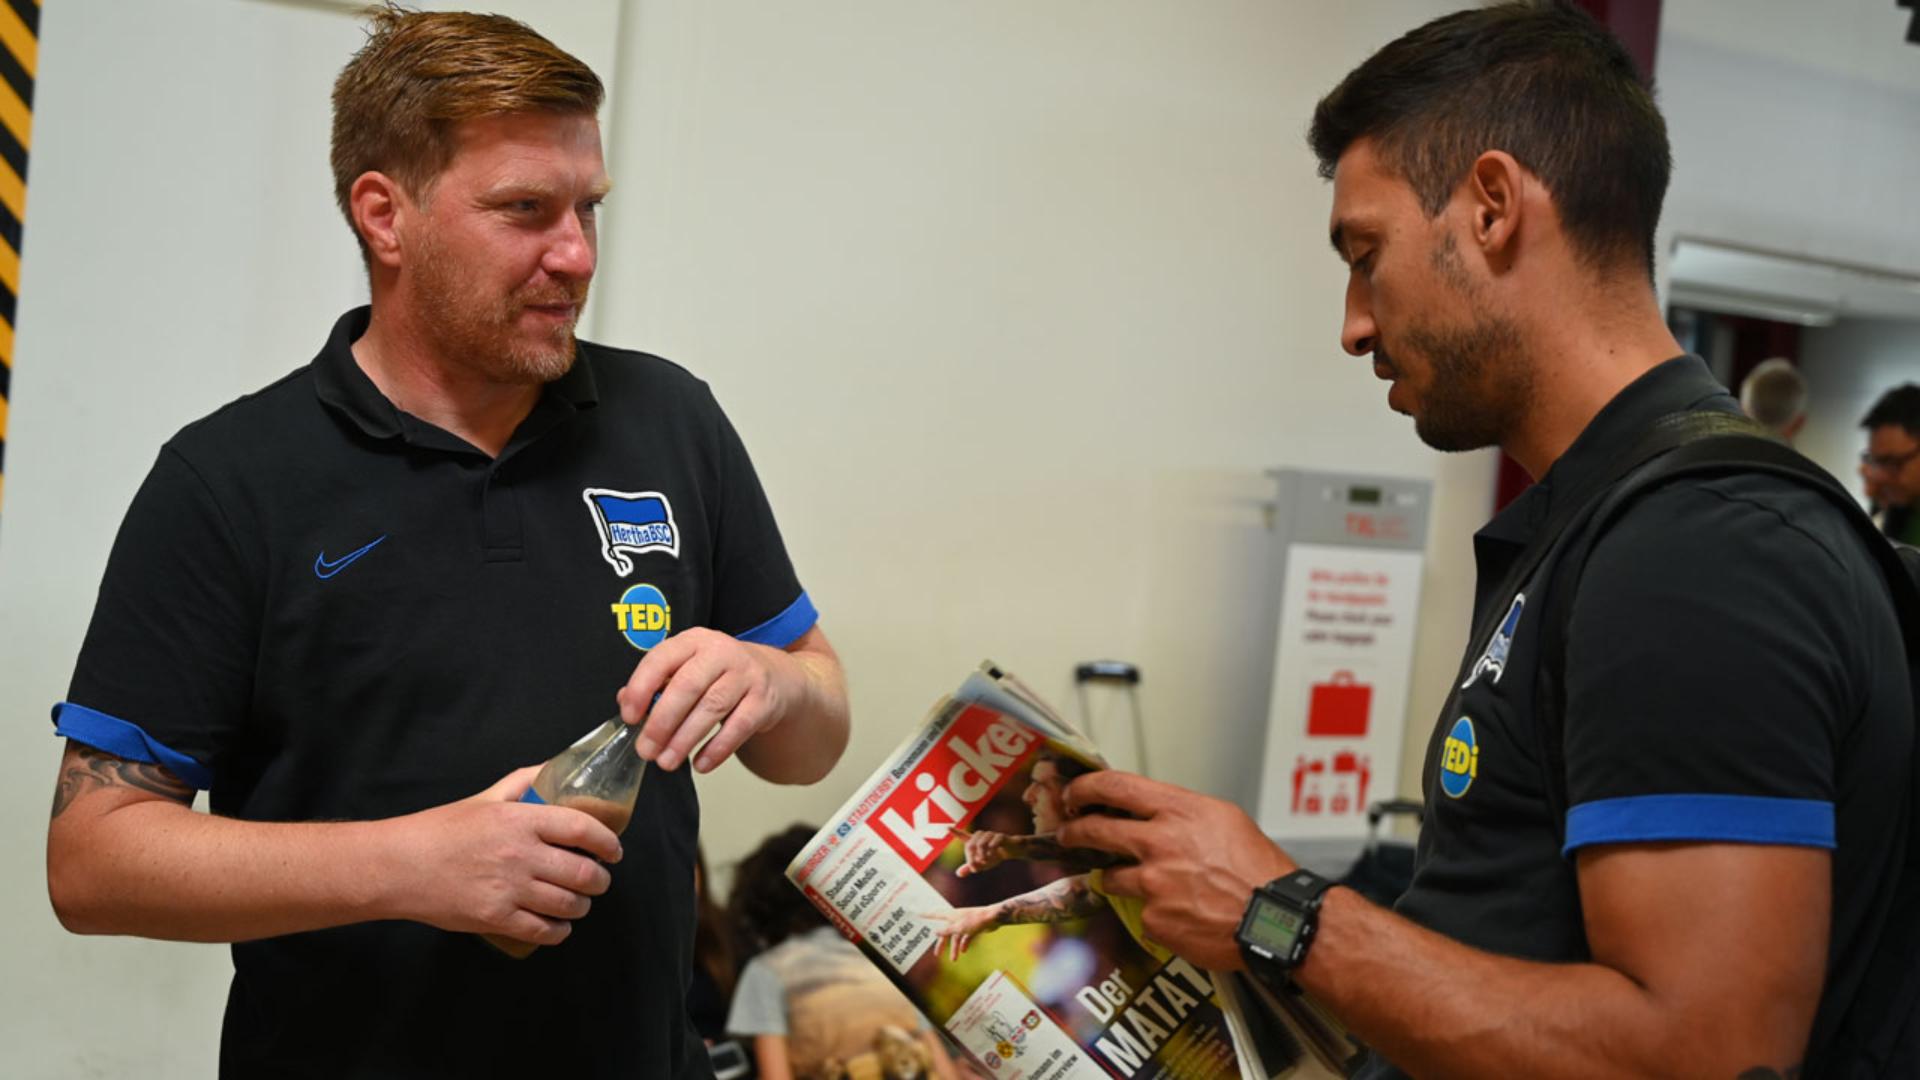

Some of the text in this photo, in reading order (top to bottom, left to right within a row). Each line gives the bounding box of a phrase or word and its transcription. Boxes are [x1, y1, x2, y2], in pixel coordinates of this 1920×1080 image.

[611, 603, 671, 631] TEDi
[848, 777, 895, 826] STADTDERBY
[836, 889, 857, 910] Social
[854, 867, 878, 891] Media
[848, 906, 862, 921] und
[858, 880, 887, 909] eSports
[878, 906, 905, 934] Aus der
[881, 922, 913, 953] Tiefe des
[1076, 968, 1133, 1022] Der
[1095, 956, 1213, 1079] MATAT
